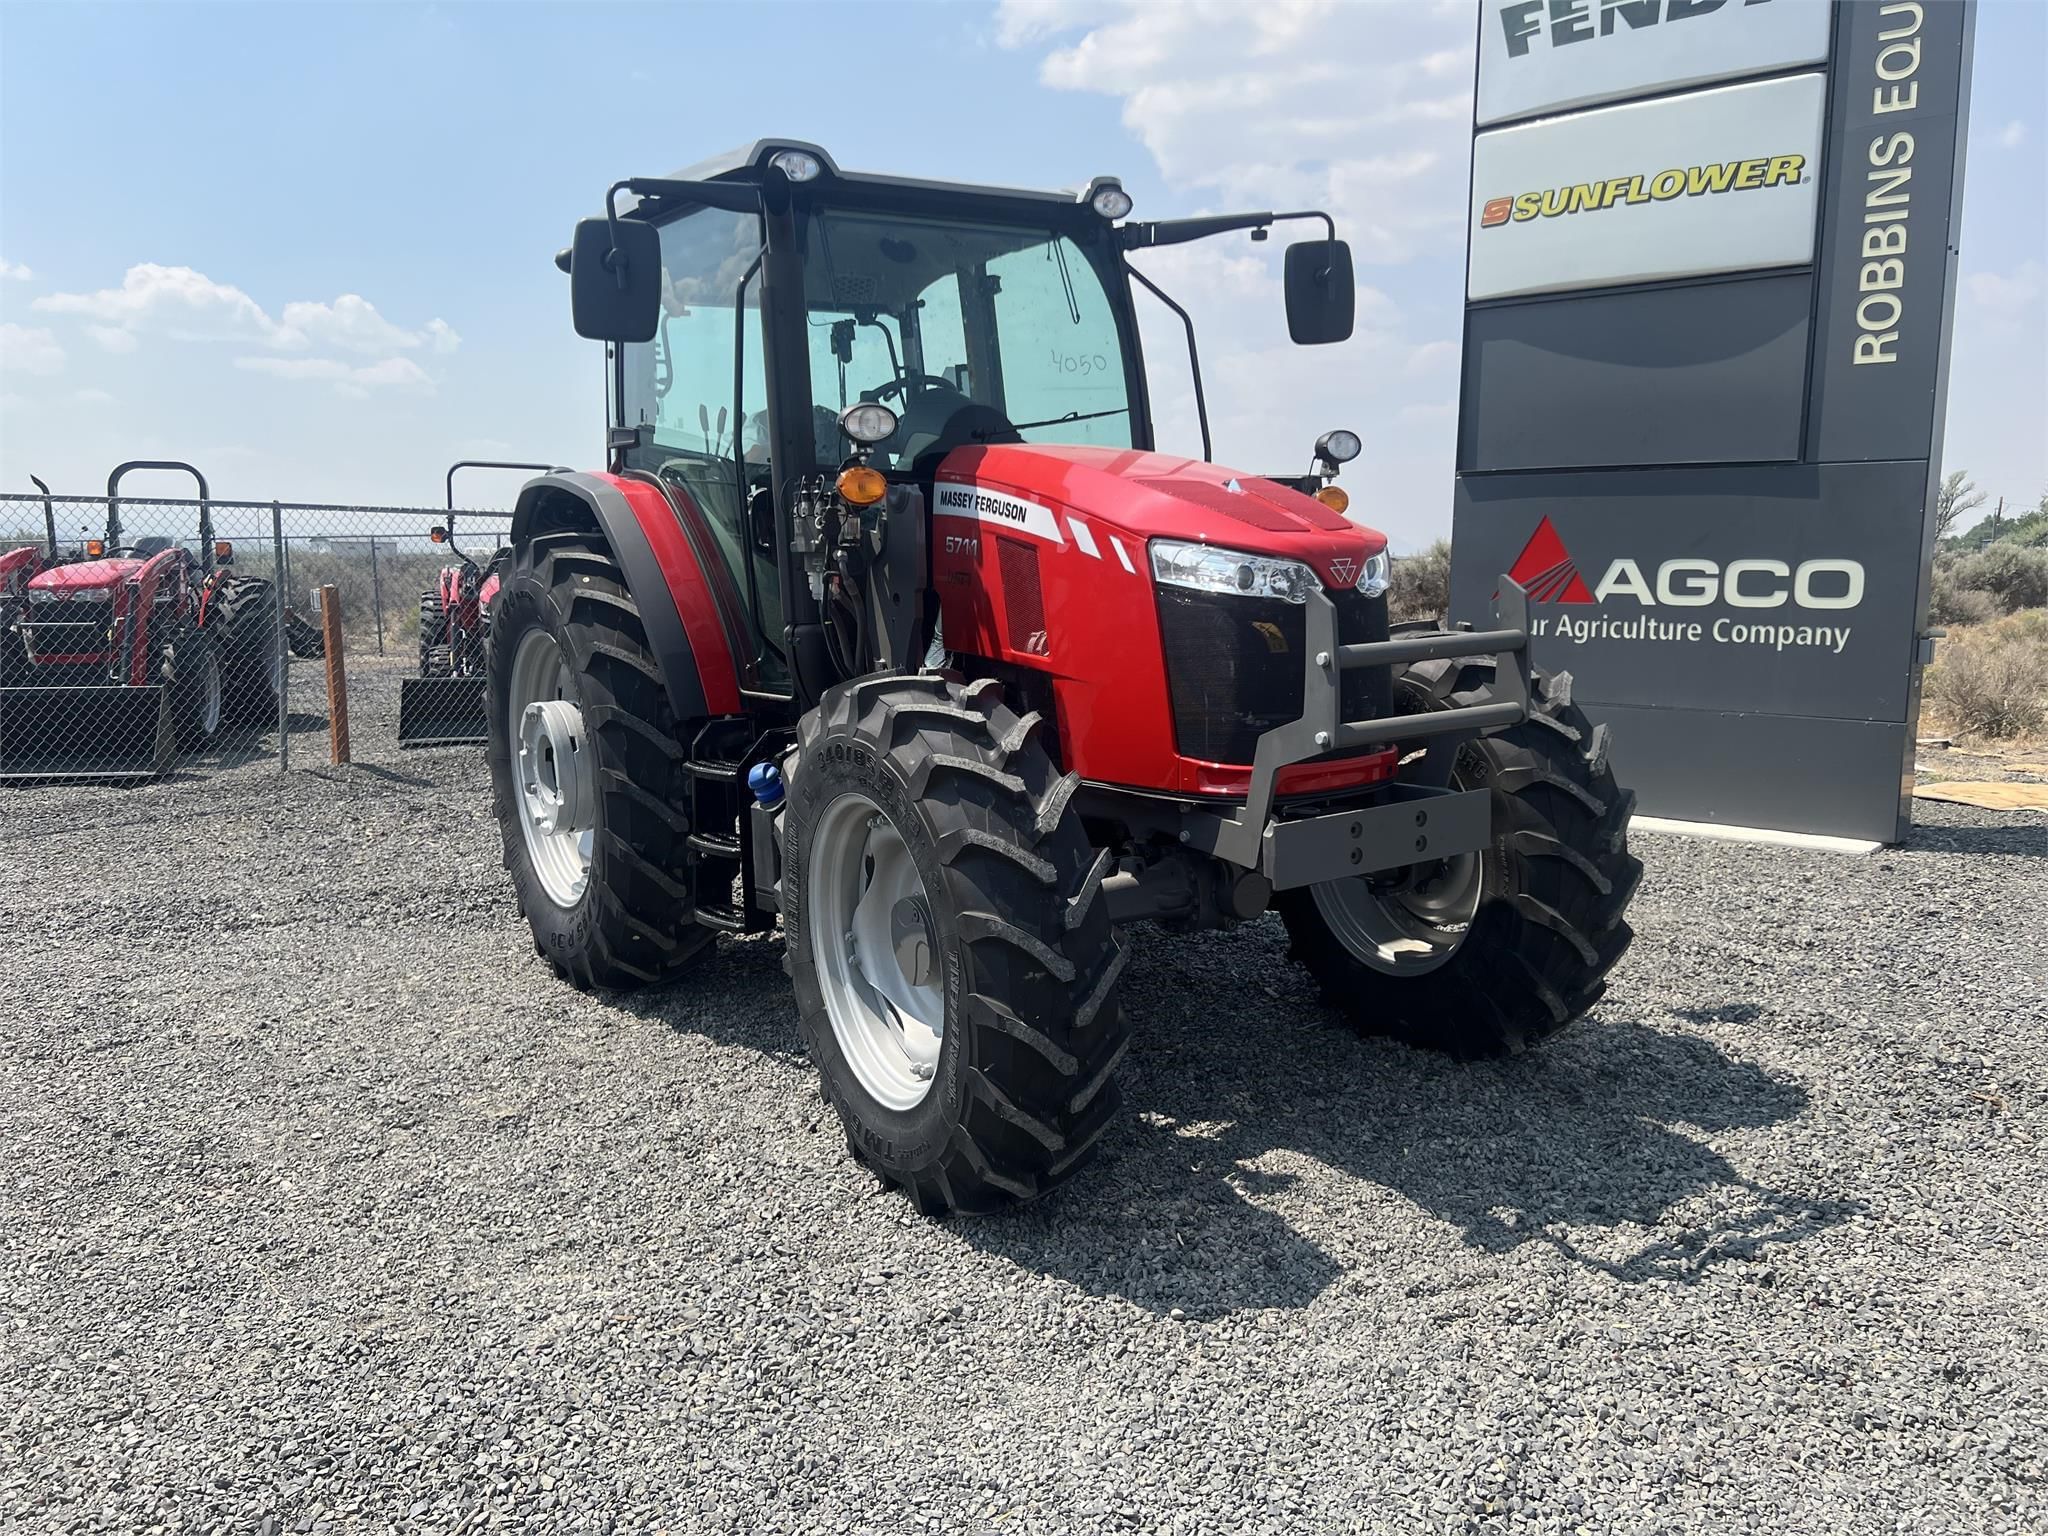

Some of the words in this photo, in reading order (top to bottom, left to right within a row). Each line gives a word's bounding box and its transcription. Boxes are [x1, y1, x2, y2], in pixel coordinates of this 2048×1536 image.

[1500, 0, 1772, 58] FEN
[1873, 1, 1924, 115] EQU
[1512, 154, 1806, 222] SUNFLOWER
[1853, 131, 1915, 365] ROBBINS
[1051, 349, 1107, 376] 4050
[940, 490, 973, 510] MASSEY
[975, 495, 1027, 523] FERGUSON
[945, 536, 978, 556] 5711
[1594, 558, 1865, 609] AGCO
[1555, 613, 1702, 644] Agriculture
[1712, 618, 1851, 653] Company
